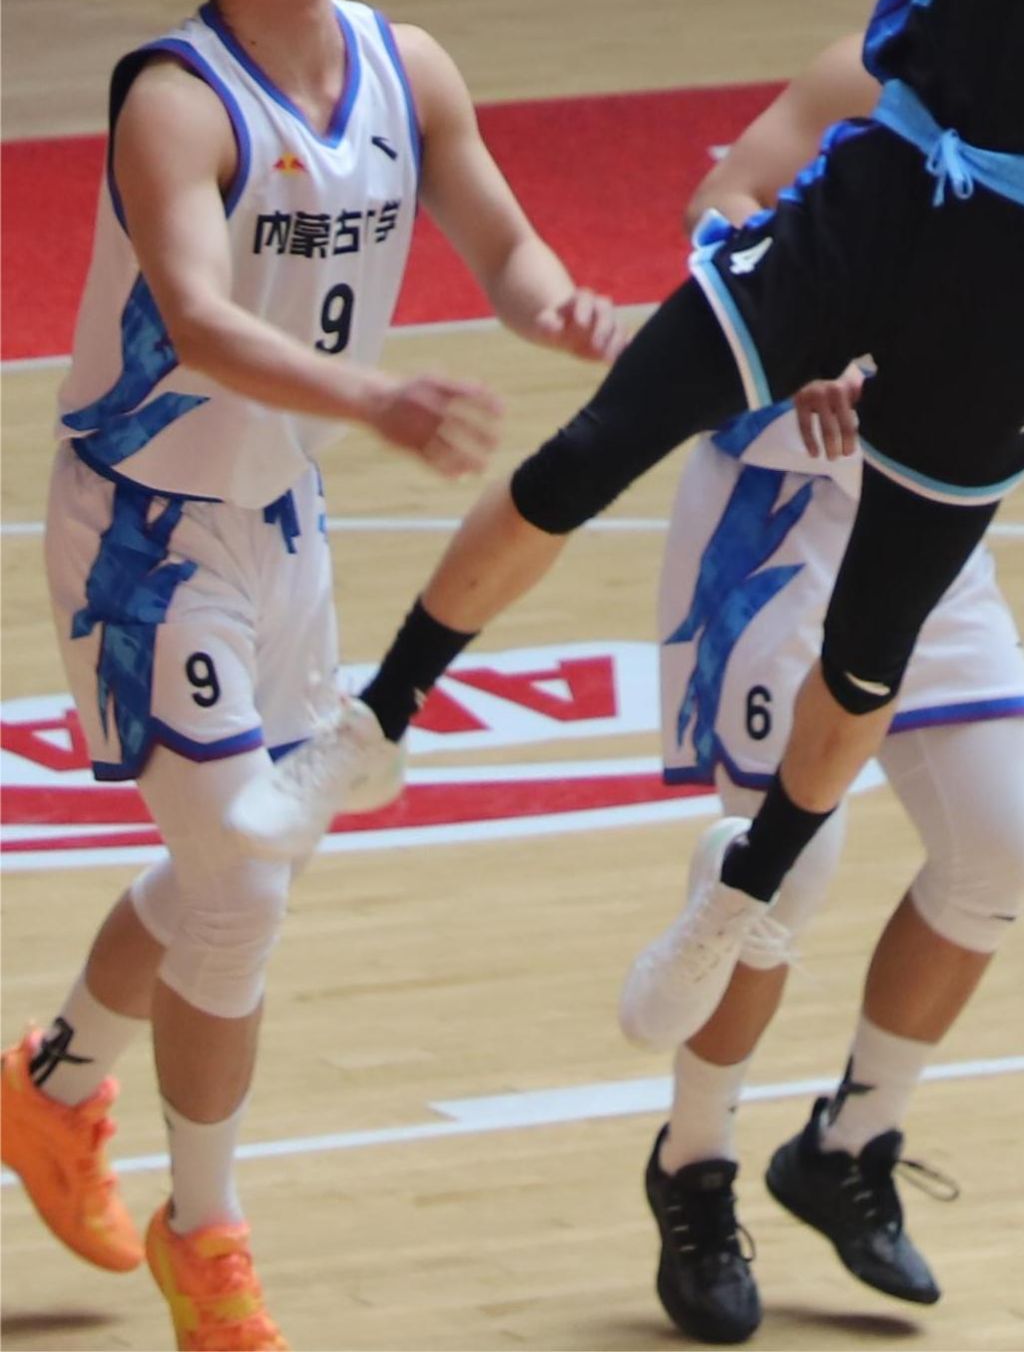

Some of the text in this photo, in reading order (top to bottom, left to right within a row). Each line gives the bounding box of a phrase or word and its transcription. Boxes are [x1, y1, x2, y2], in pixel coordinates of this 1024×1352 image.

[729, 236, 773, 275] 4
[315, 282, 355, 356] 9
[186, 651, 221, 709] 9
[746, 684, 772, 741] 6
